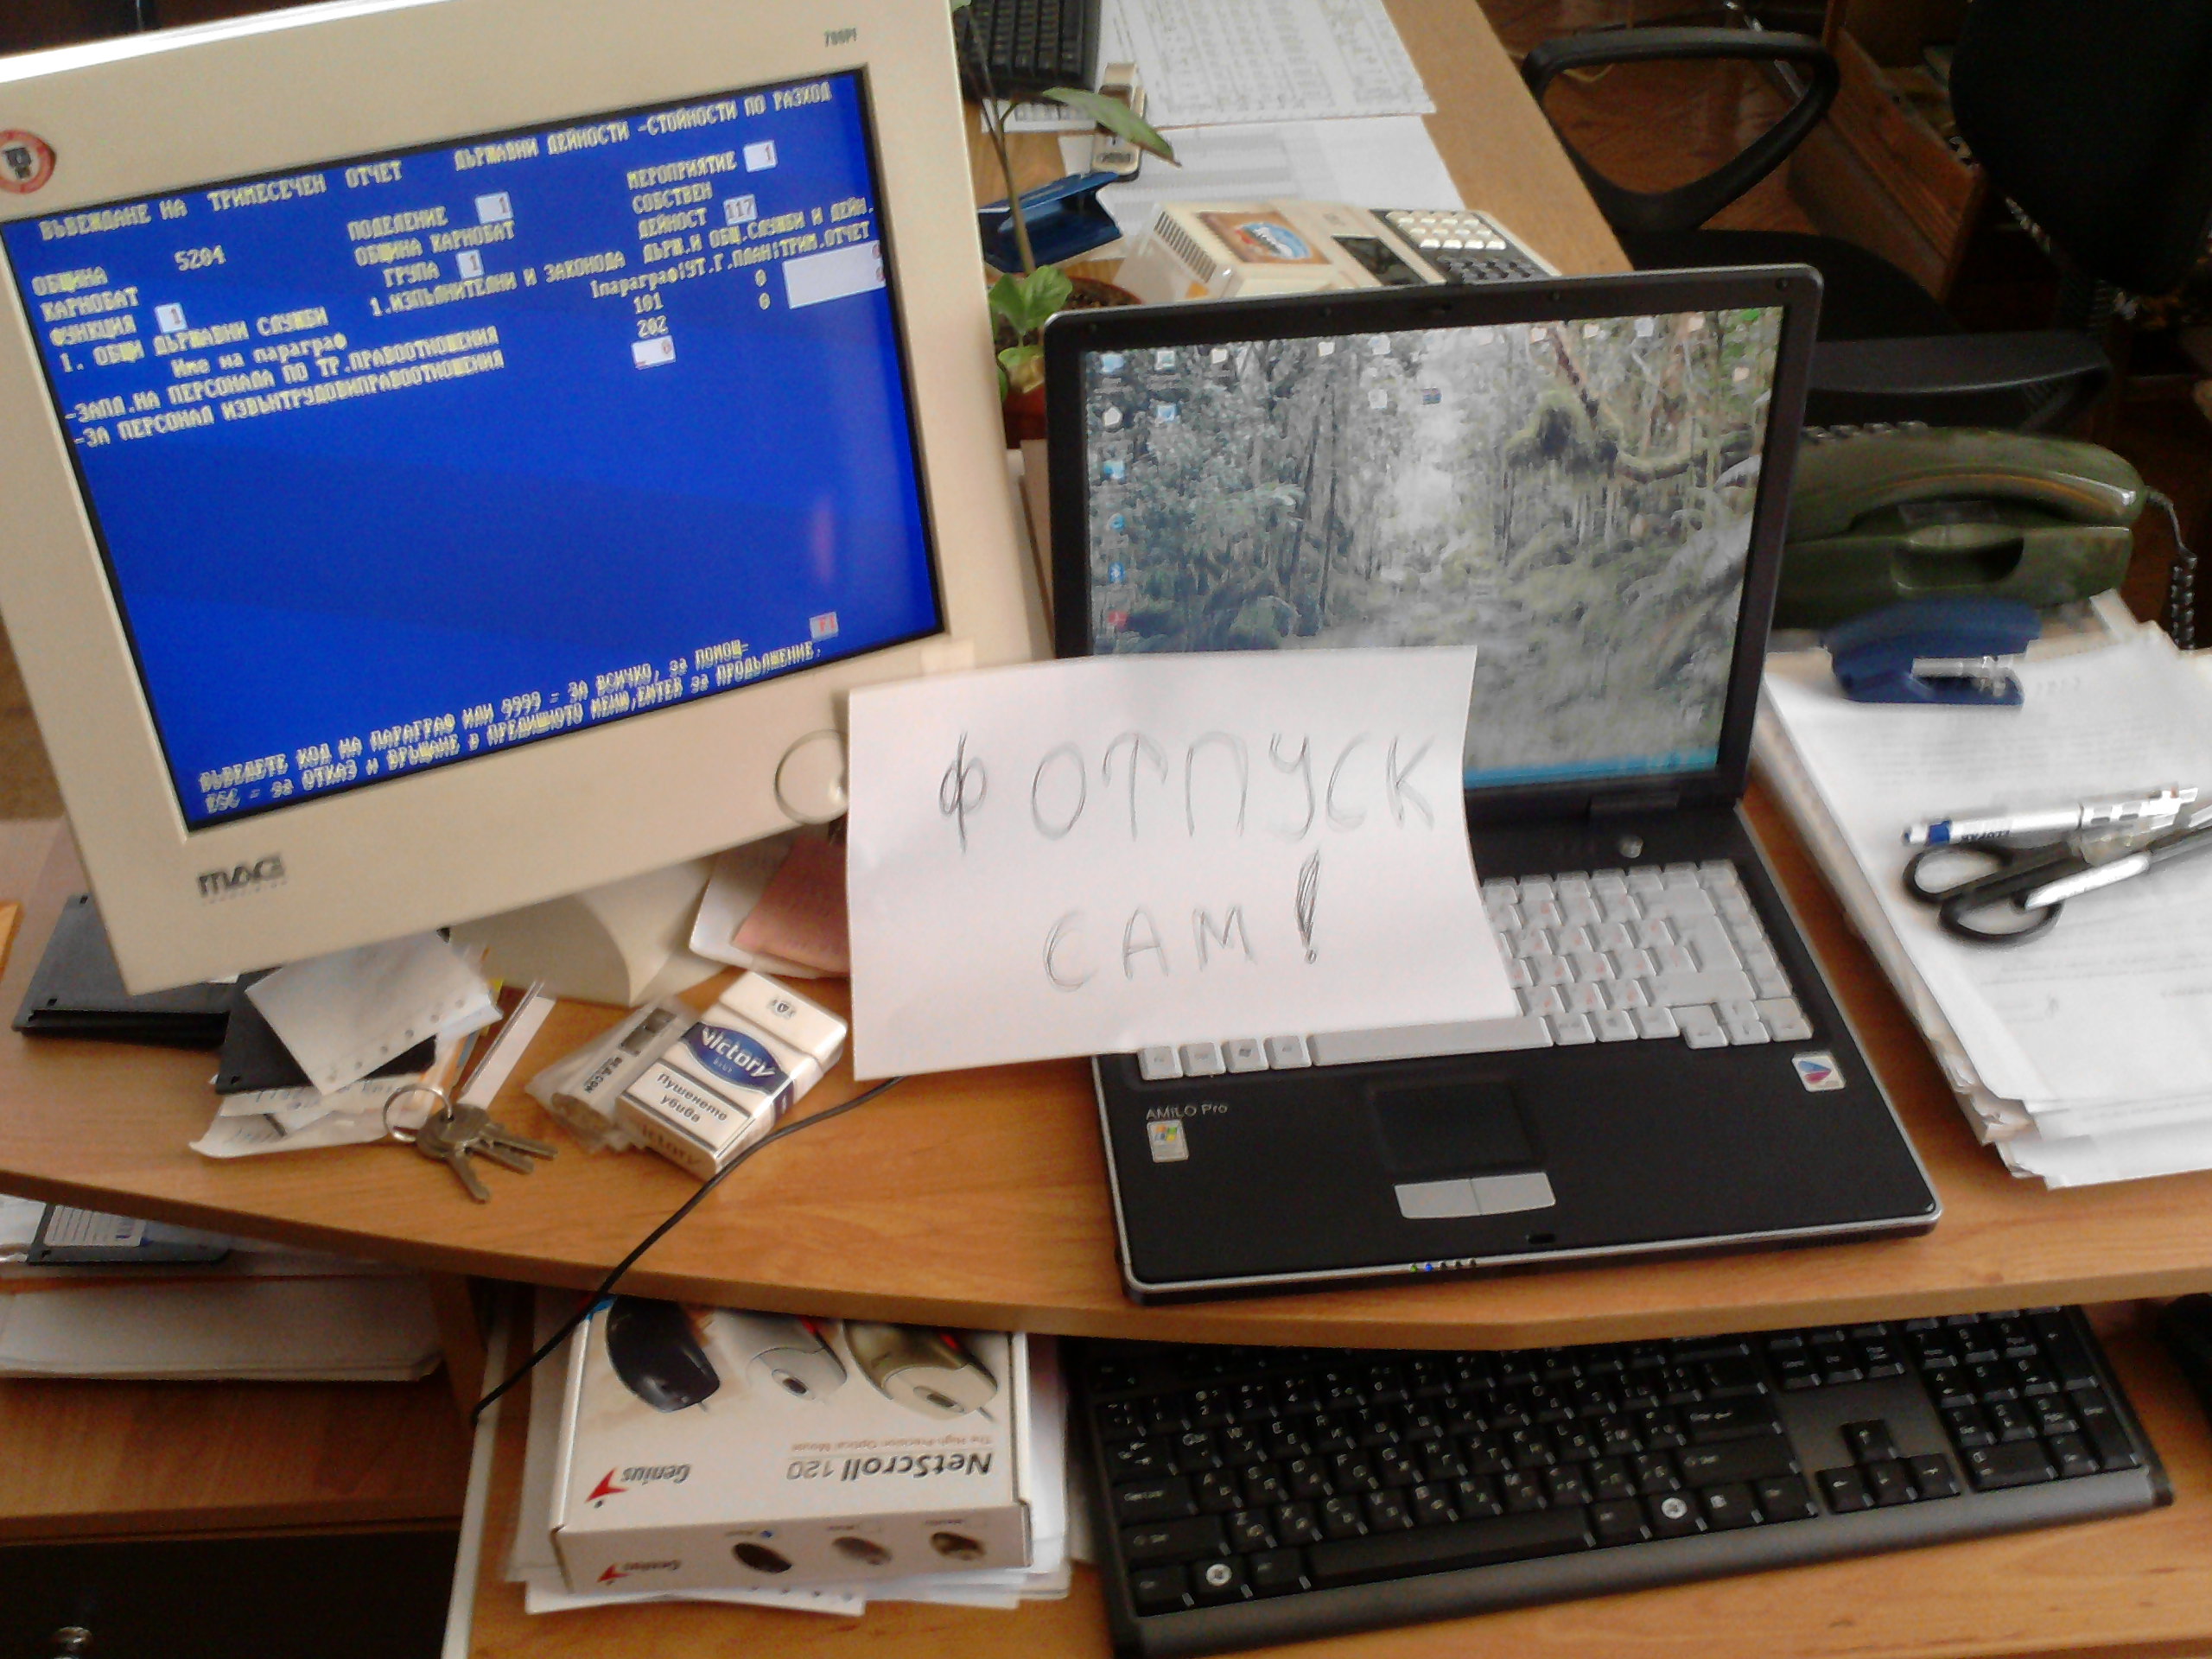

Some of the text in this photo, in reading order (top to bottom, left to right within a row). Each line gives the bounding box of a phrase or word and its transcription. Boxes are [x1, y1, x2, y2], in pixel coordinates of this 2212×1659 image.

[745, 95, 764, 115] ПО
[763, 146, 772, 162] 1
[159, 199, 188, 219] НА
[346, 161, 403, 187] ОТЧЕТ
[498, 196, 508, 214] 1
[726, 199, 753, 219] 117
[811, 207, 823, 226] И
[355, 219, 515, 266] ОБЩИНА КАРНОБАТ
[32, 245, 225, 296] ОБЩИНА 5204
[384, 253, 479, 286] ГРУПА 1
[523, 267, 537, 286] И
[41, 289, 139, 321] КАРНОБАТ
[633, 293, 662, 313] 101
[169, 307, 182, 326] 1
[637, 315, 667, 338] 202
[219, 352, 243, 369] на
[282, 362, 308, 384] ПО
[118, 407, 213, 440] ПЕРСОНАЛ
[296, 743, 331, 768] КОД
[338, 735, 362, 758] НА
[500, 692, 542, 718] 9999
[819, 614, 835, 632] F1
[657, 1073, 728, 1121] Пушенето
[660, 1094, 701, 1122] убива
[1146, 1103, 1229, 1121] AMILO Pro
[622, 1463, 691, 1485] Genius
[786, 1452, 993, 1484] NetScroll 120
